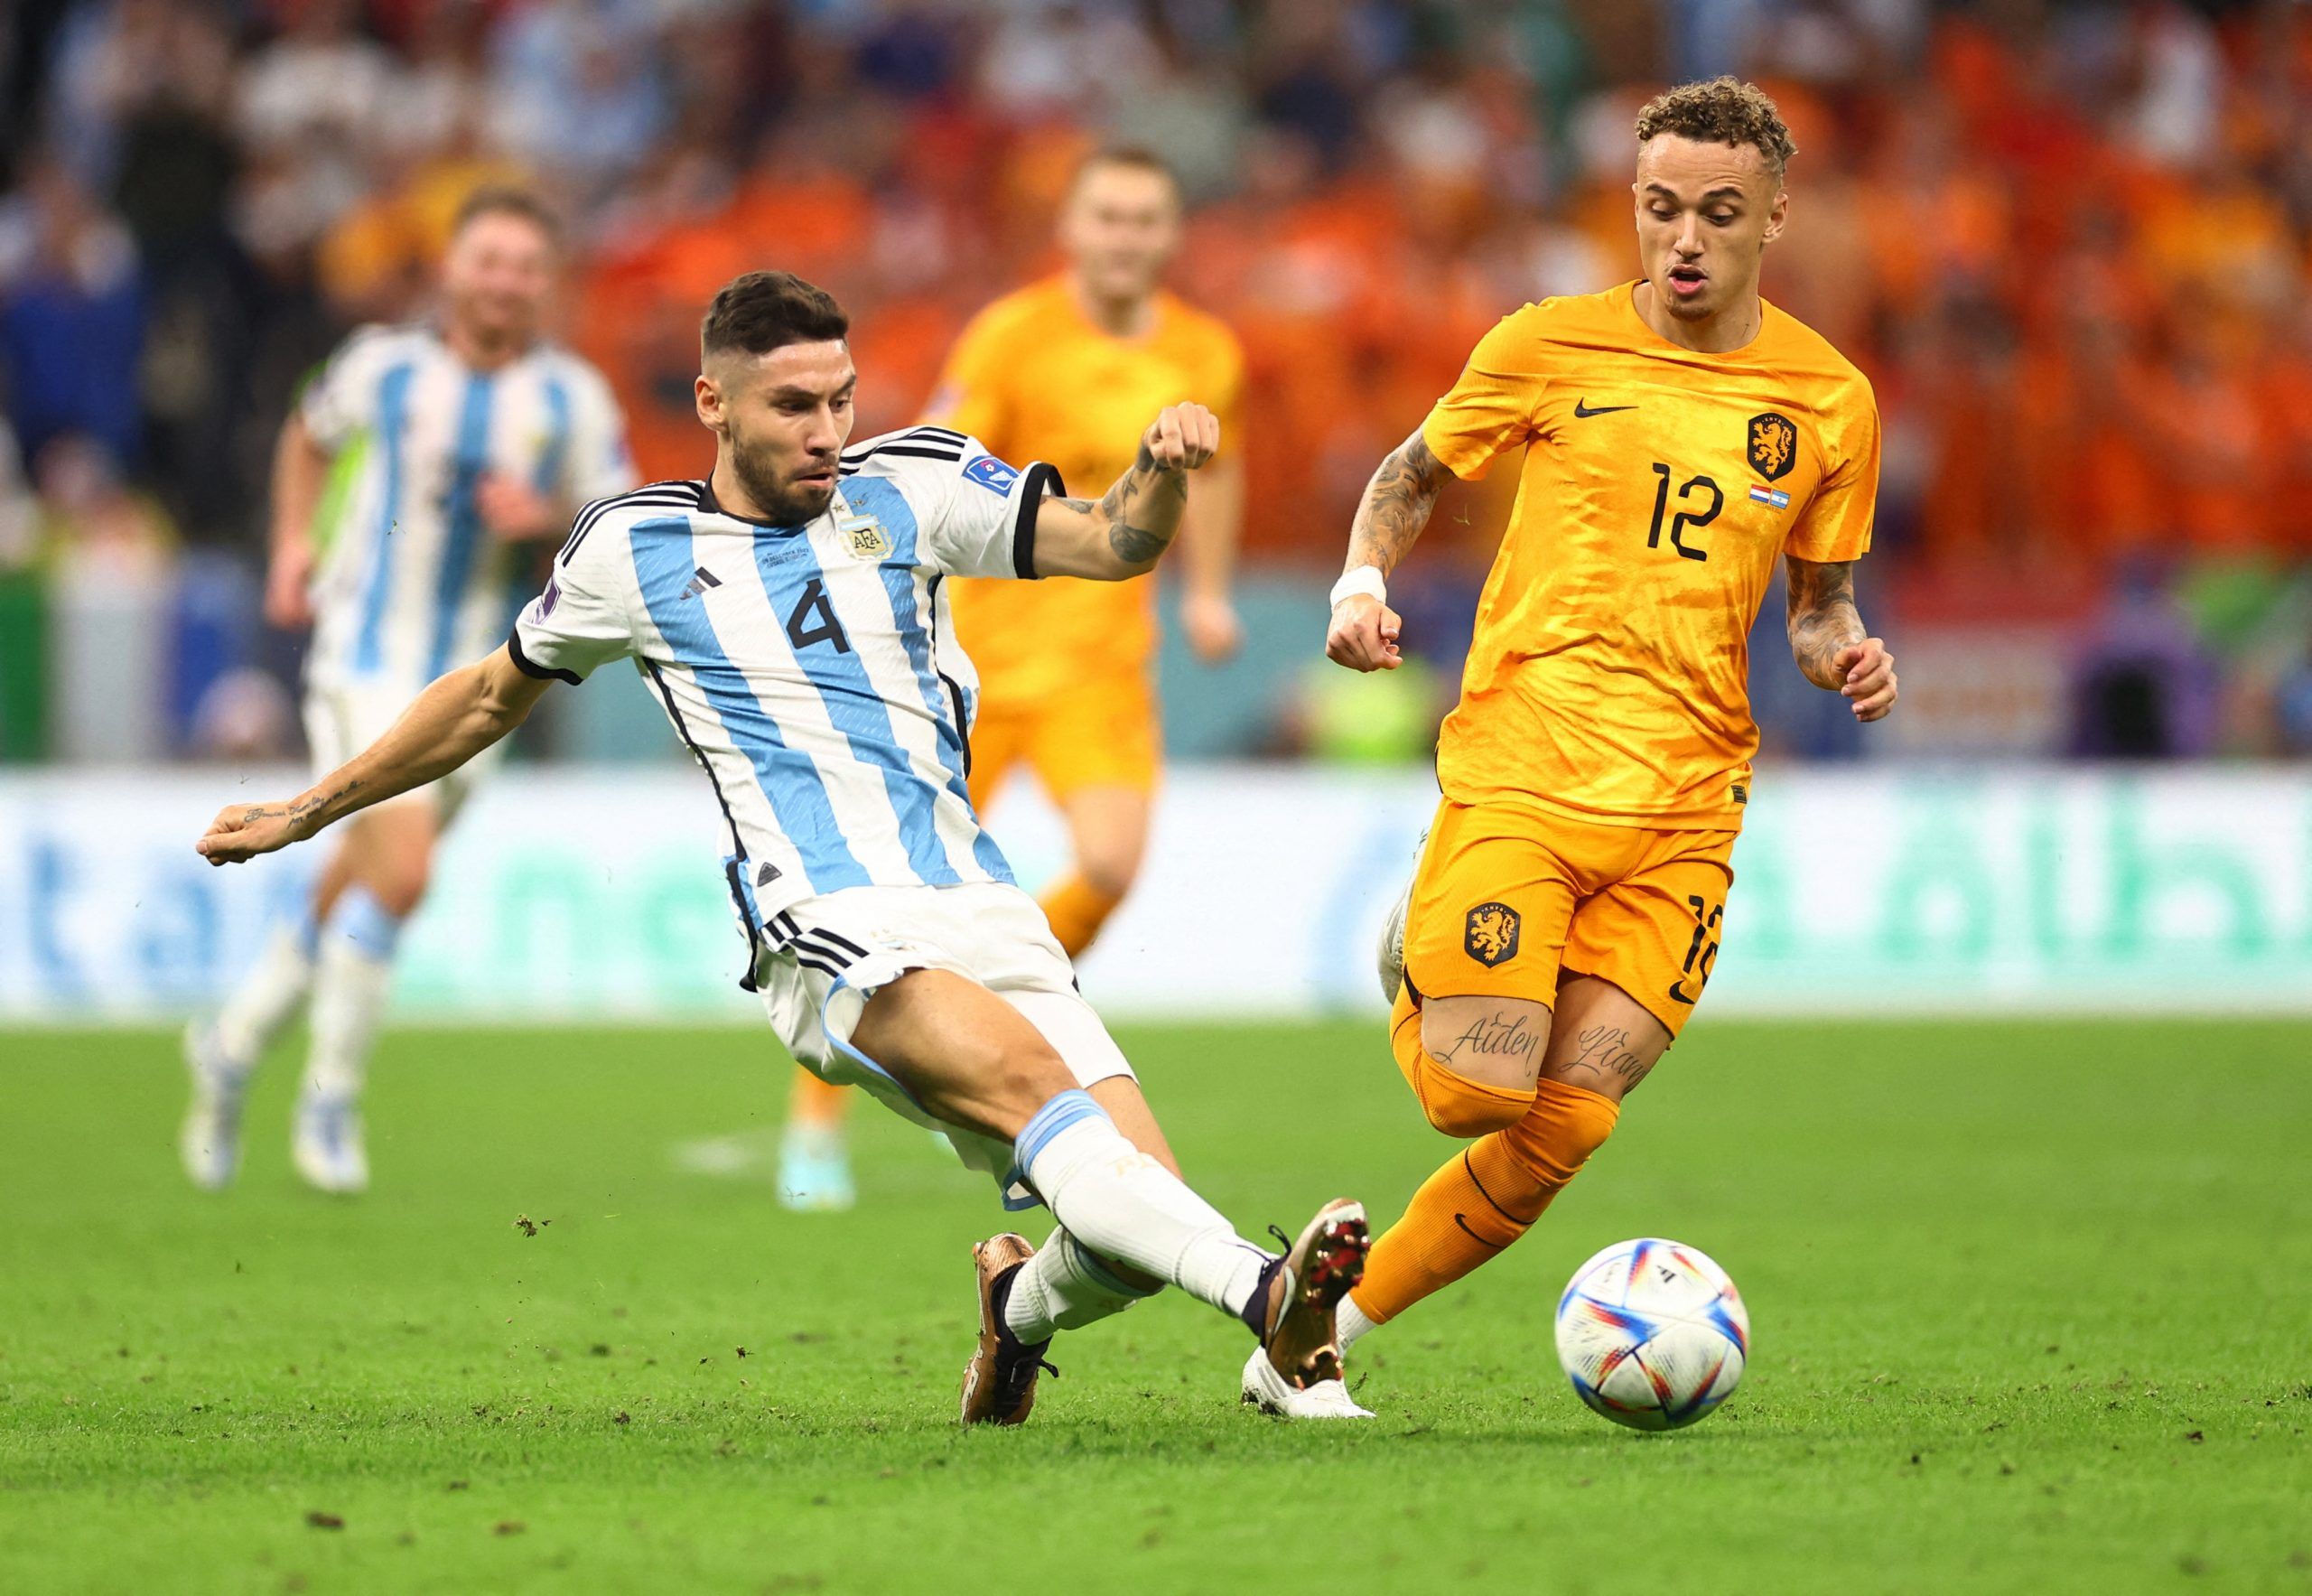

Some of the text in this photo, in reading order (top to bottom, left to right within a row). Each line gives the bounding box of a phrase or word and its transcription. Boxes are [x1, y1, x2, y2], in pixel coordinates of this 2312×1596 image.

[853, 527, 881, 550] AFA
[1647, 462, 1724, 562] 12
[786, 578, 851, 654] 4
[1431, 1012, 1539, 1078] Aiden
